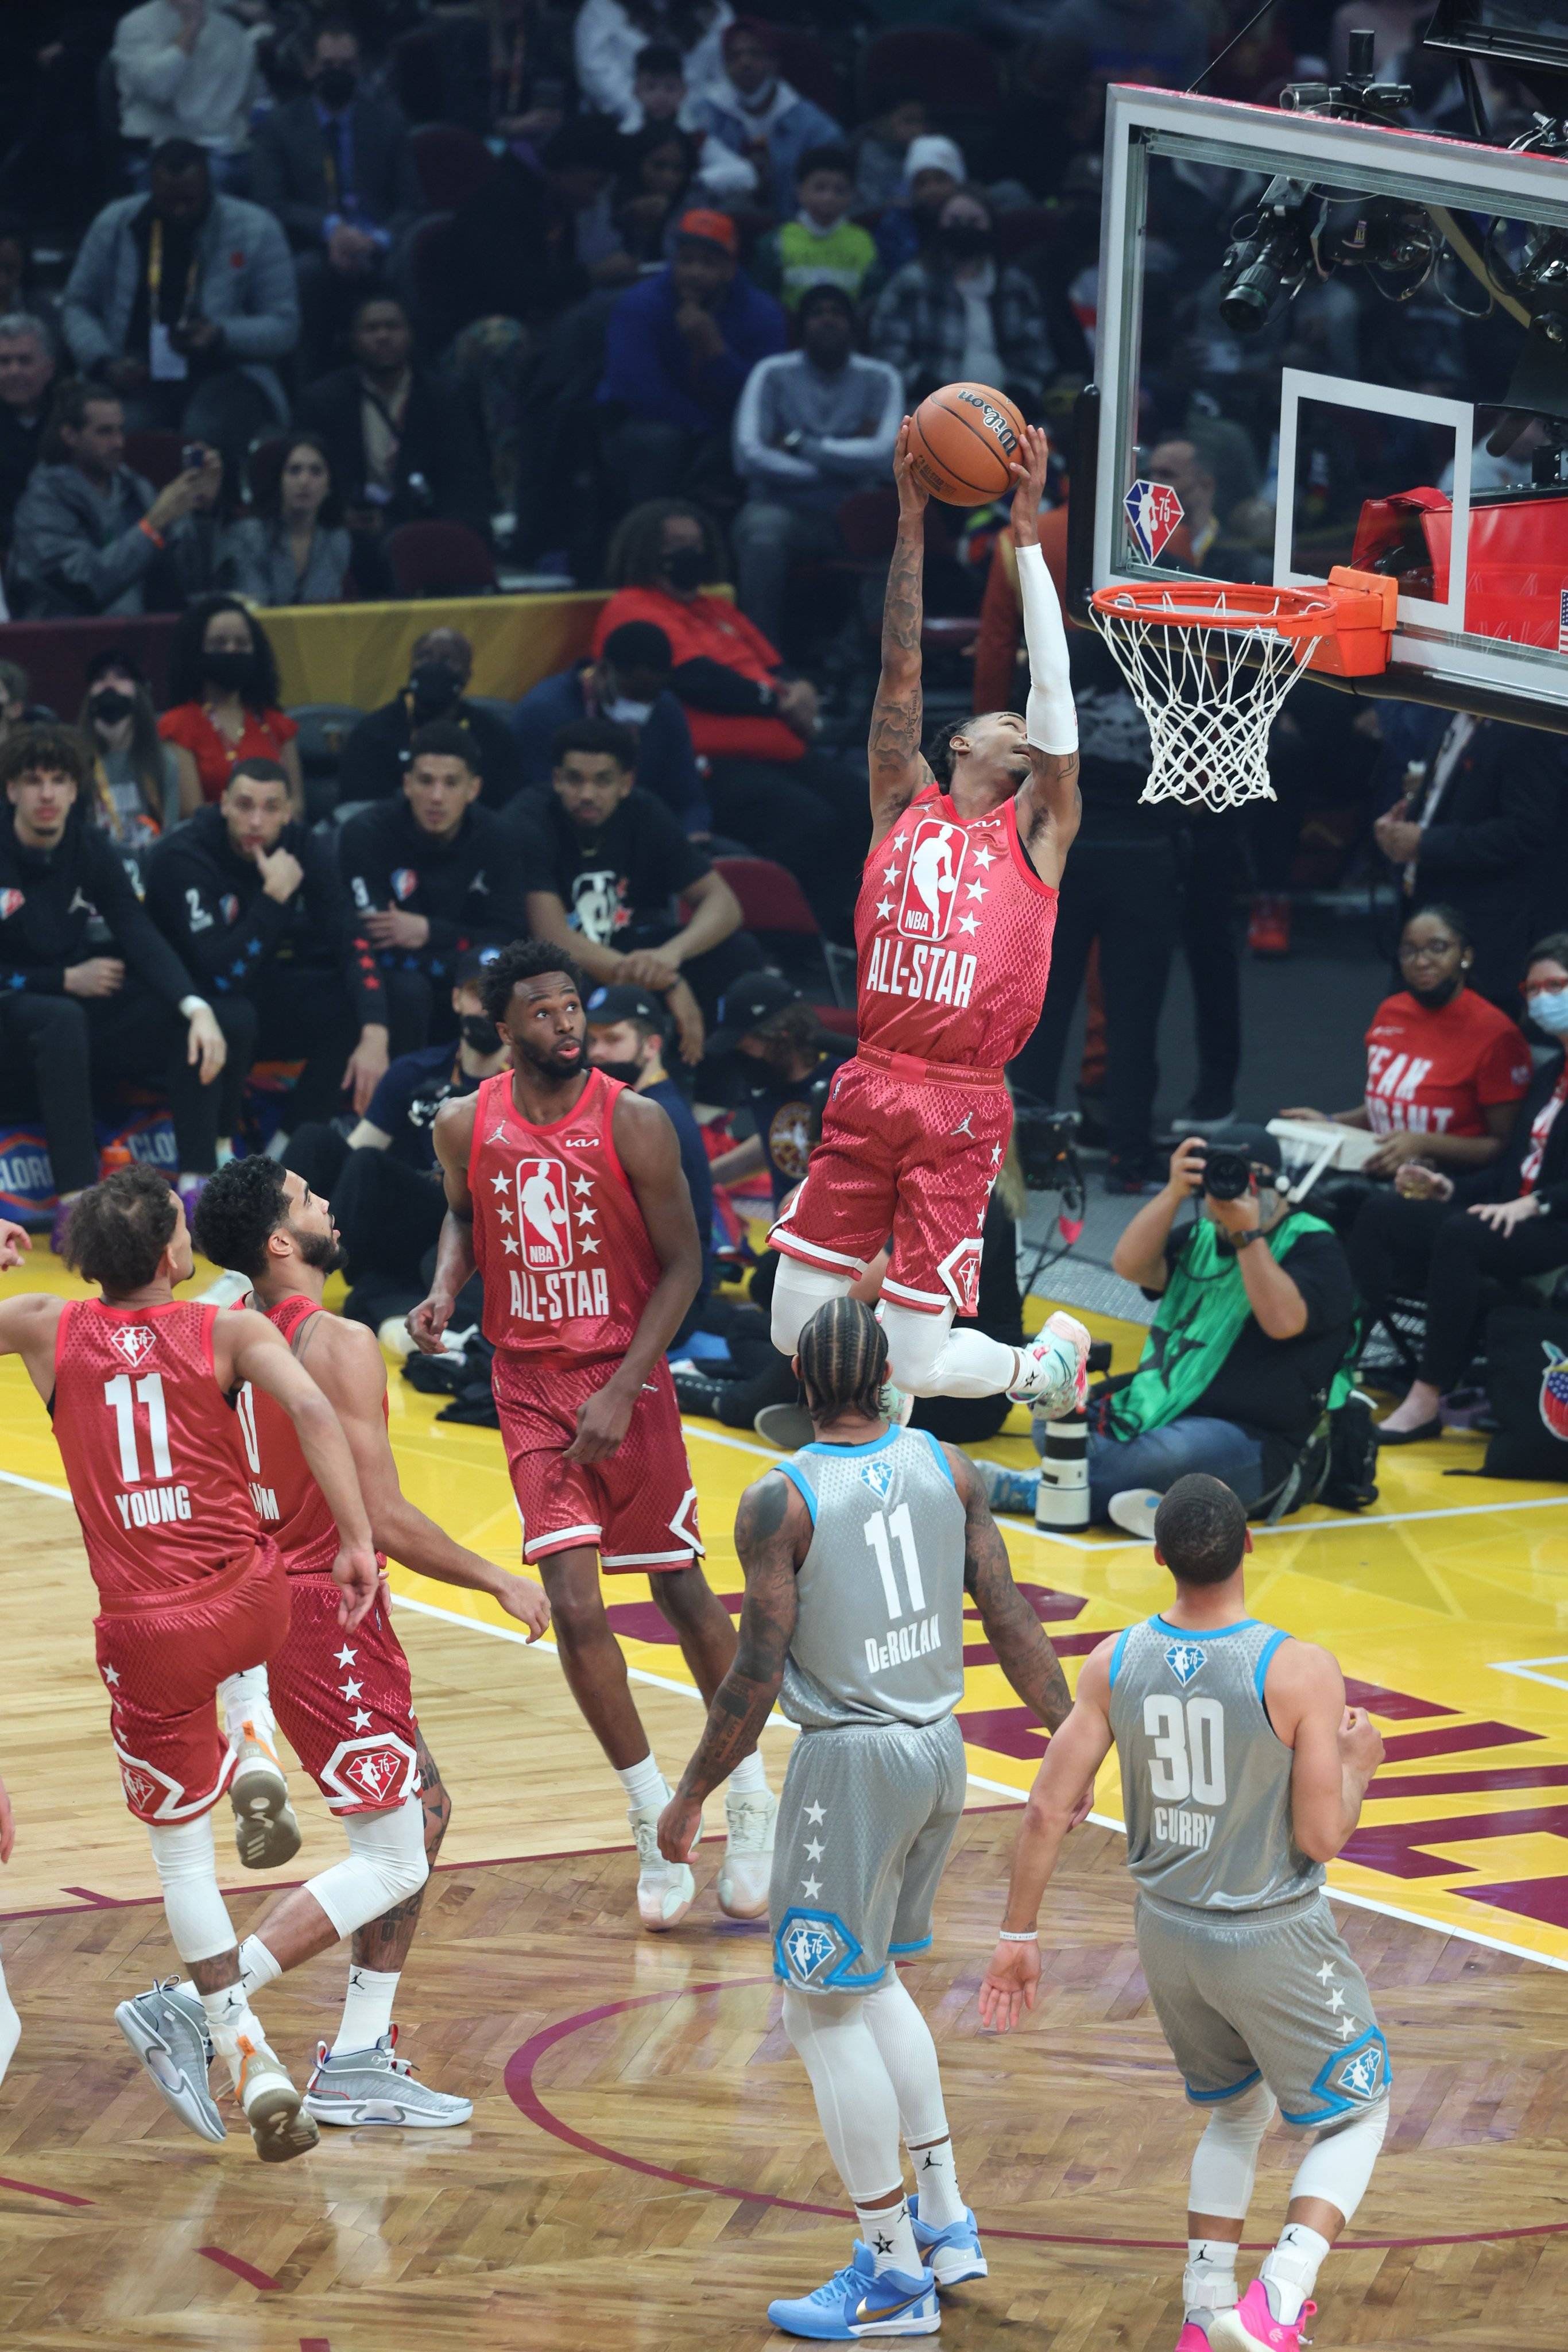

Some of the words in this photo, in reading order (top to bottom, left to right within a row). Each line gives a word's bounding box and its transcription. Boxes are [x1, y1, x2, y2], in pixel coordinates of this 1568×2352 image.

[957, 389, 1019, 458] Wilson
[1159, 497, 1171, 522] 75
[905, 910, 930, 932] NBA
[866, 937, 978, 1009] ALL-STAR
[565, 1139, 599, 1147] KIA
[529, 1245, 554, 1263] NBA
[509, 1268, 609, 1322] ALL-STAR
[103, 1372, 173, 1483] 11
[115, 1485, 192, 1530] YOUNG
[863, 1502, 926, 1620] 11
[865, 1613, 942, 1674] DeROZAN
[1190, 1651, 1198, 1665] 75
[378, 1758, 390, 1773] 75
[1143, 1694, 1226, 1806] 30
[1154, 1806, 1215, 1850] CURRY
[811, 1938, 823, 1954] 75
